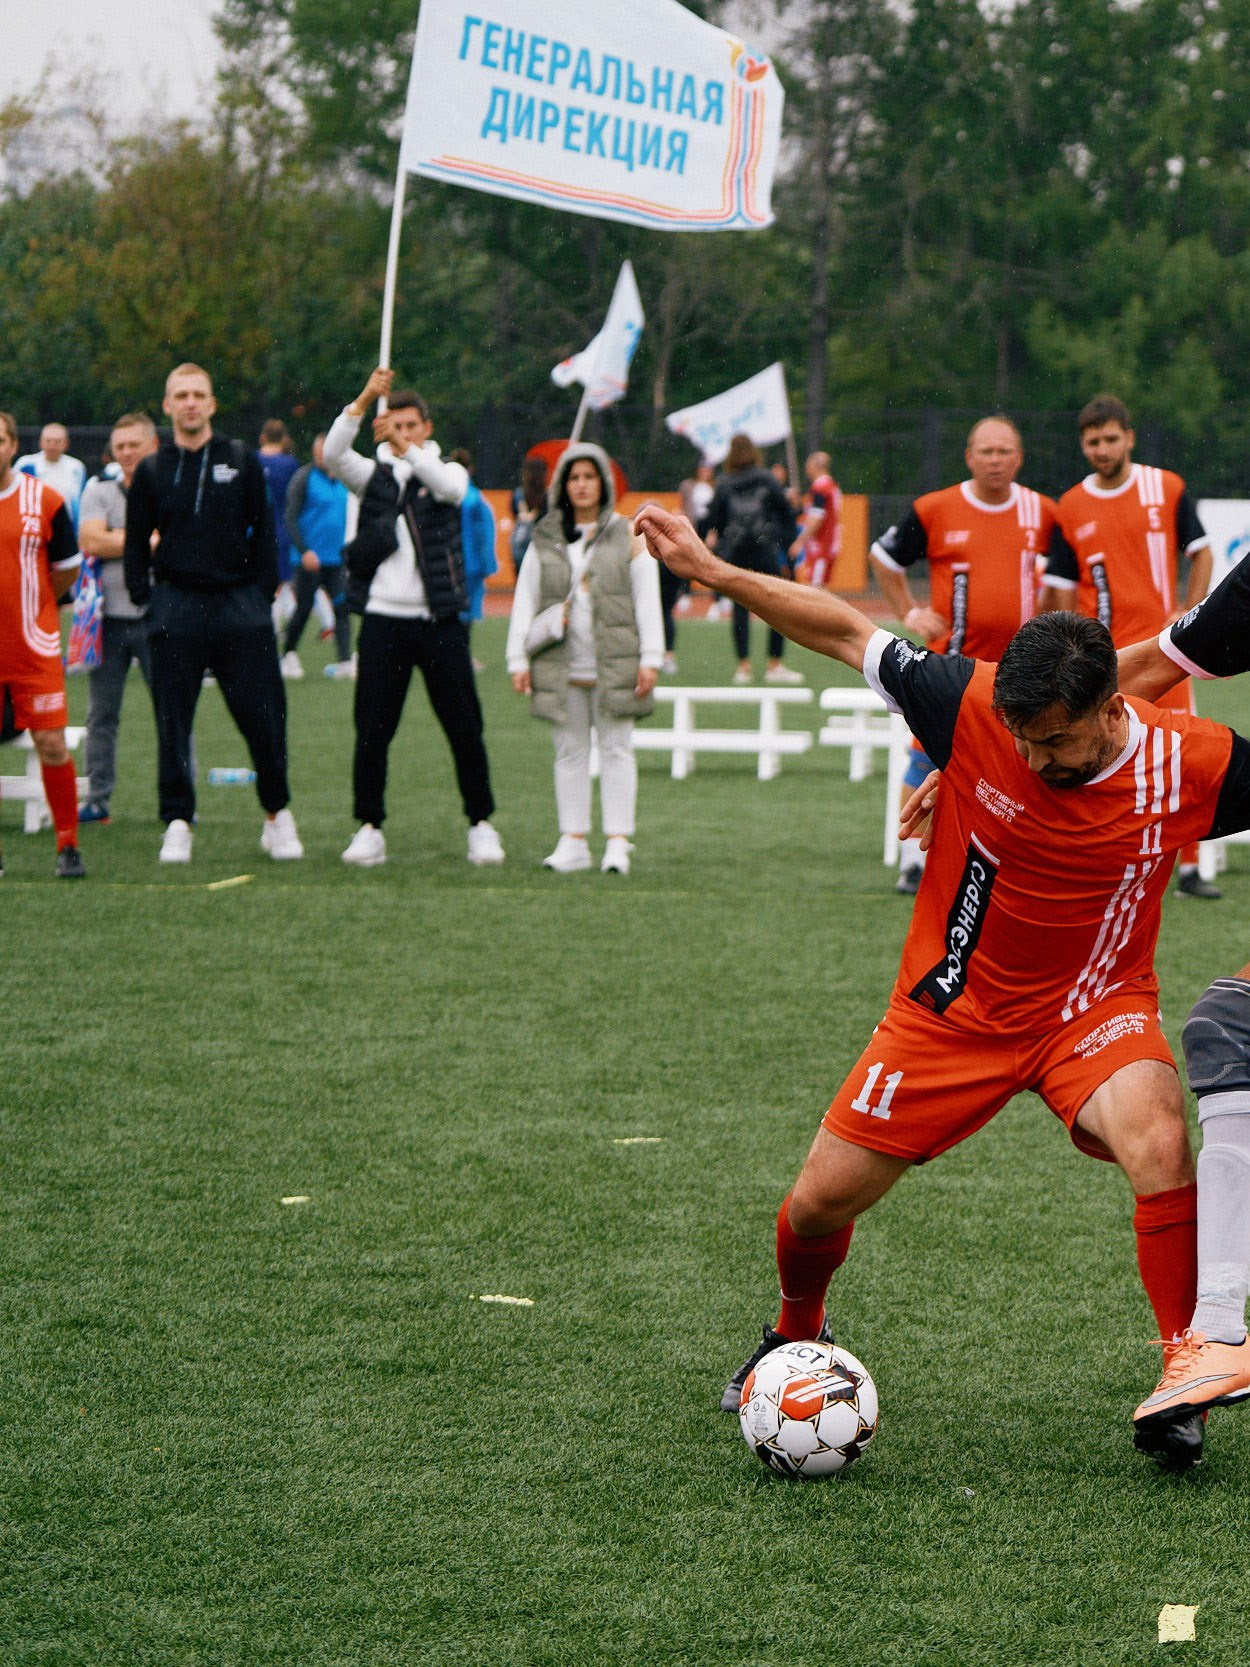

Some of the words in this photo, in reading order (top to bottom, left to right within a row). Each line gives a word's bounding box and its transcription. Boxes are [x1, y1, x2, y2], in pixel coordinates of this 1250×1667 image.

[459, 15, 724, 126] ГЕНЕРАЛЬНАЯ
[480, 86, 689, 176] ДИРЕКЦИЯ
[976, 785, 1016, 817] ФЕСТИВАЛЬ
[978, 778, 1025, 812] СПОРТИВНЫЙ
[1139, 821, 1163, 855] 11
[936, 861, 986, 993] МОСЭНЕРГО
[1073, 1012, 1148, 1053] СПОРТИВНЫЙ
[850, 1061, 904, 1120] 11
[770, 1344, 825, 1364] LECT
